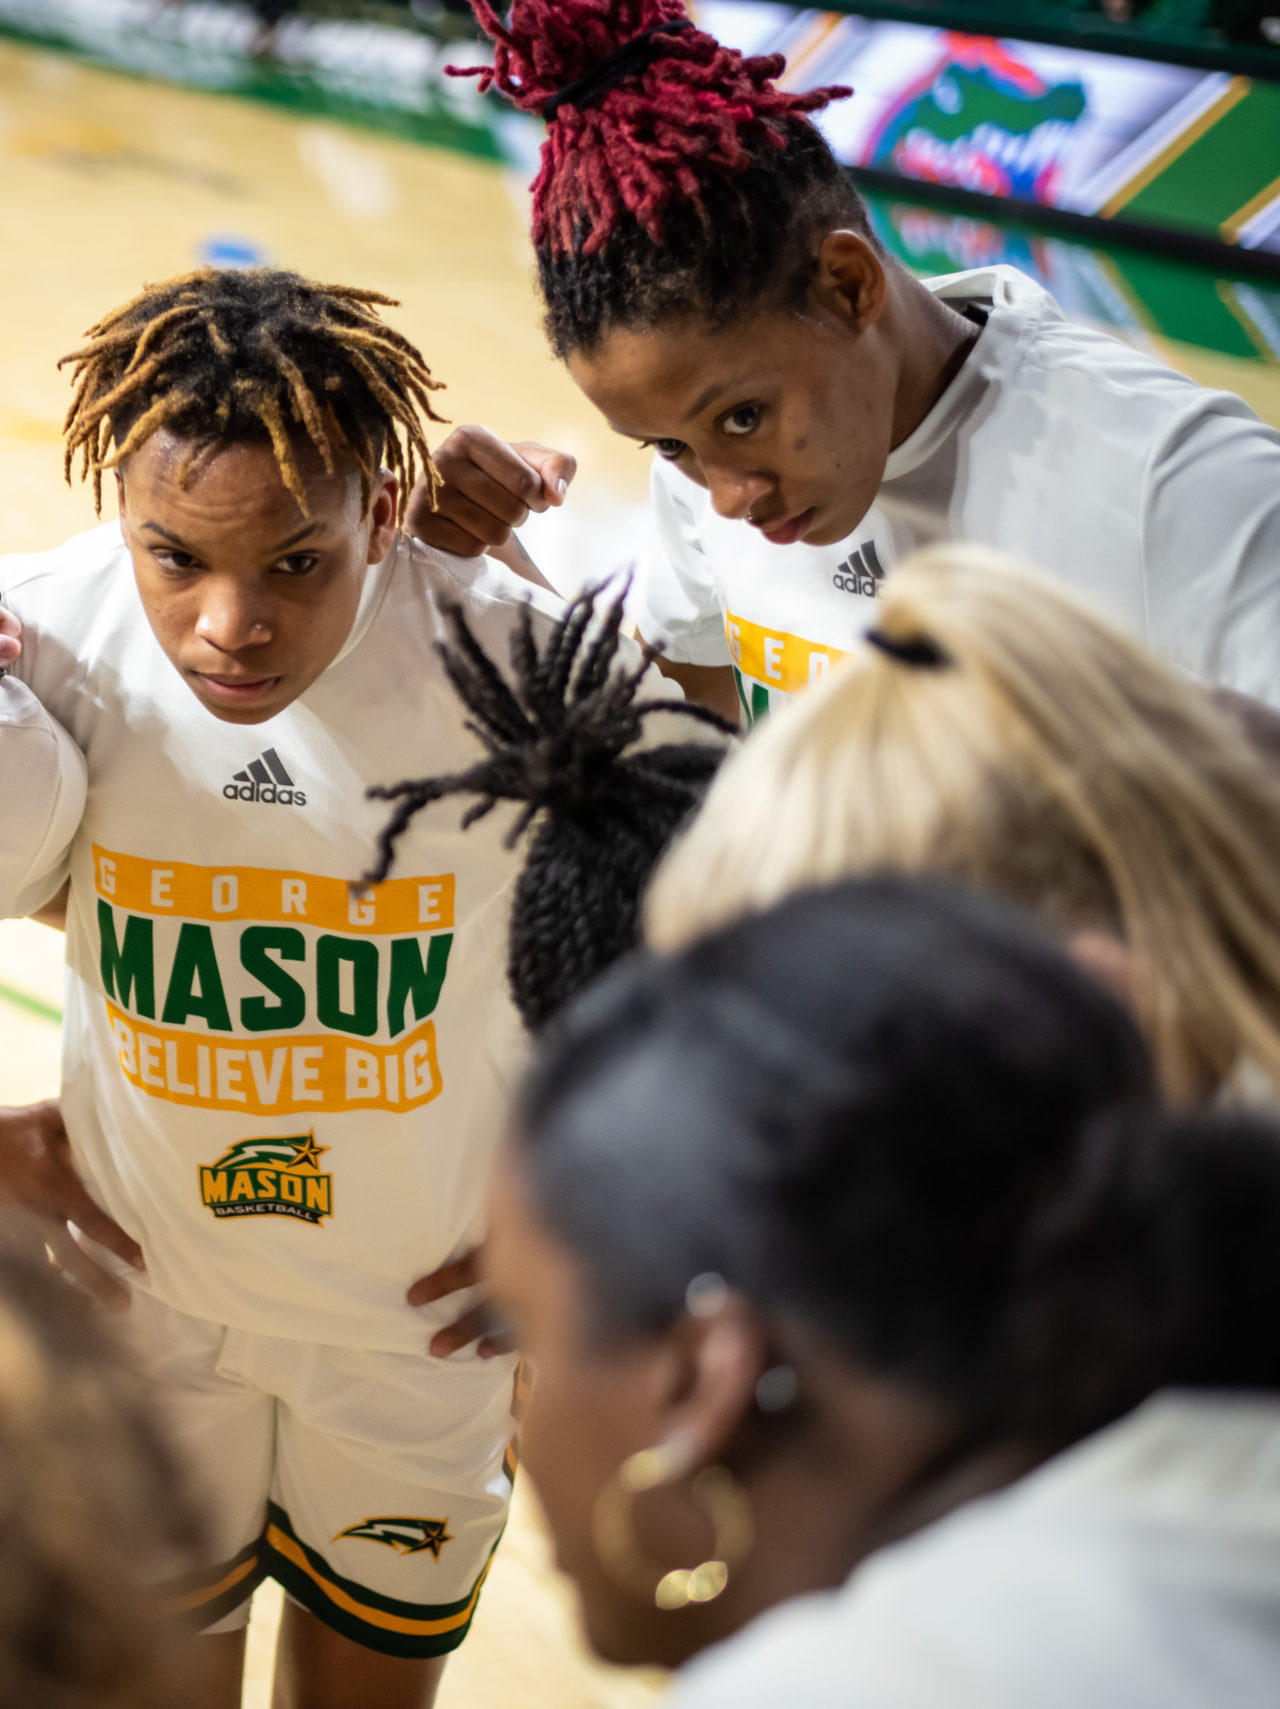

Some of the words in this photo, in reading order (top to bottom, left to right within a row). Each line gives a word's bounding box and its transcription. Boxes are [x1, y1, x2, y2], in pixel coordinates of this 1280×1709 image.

[833, 573, 876, 597] adid
[728, 620, 829, 692] GEO
[223, 781, 307, 806] adidas
[99, 856, 442, 926] GEORGE
[97, 898, 454, 1039] MASON
[112, 1016, 323, 1106] BELIEVE
[345, 1039, 433, 1104] BIG
[202, 1170, 329, 1213] MASON
[216, 1203, 314, 1220] BASKETBALL
